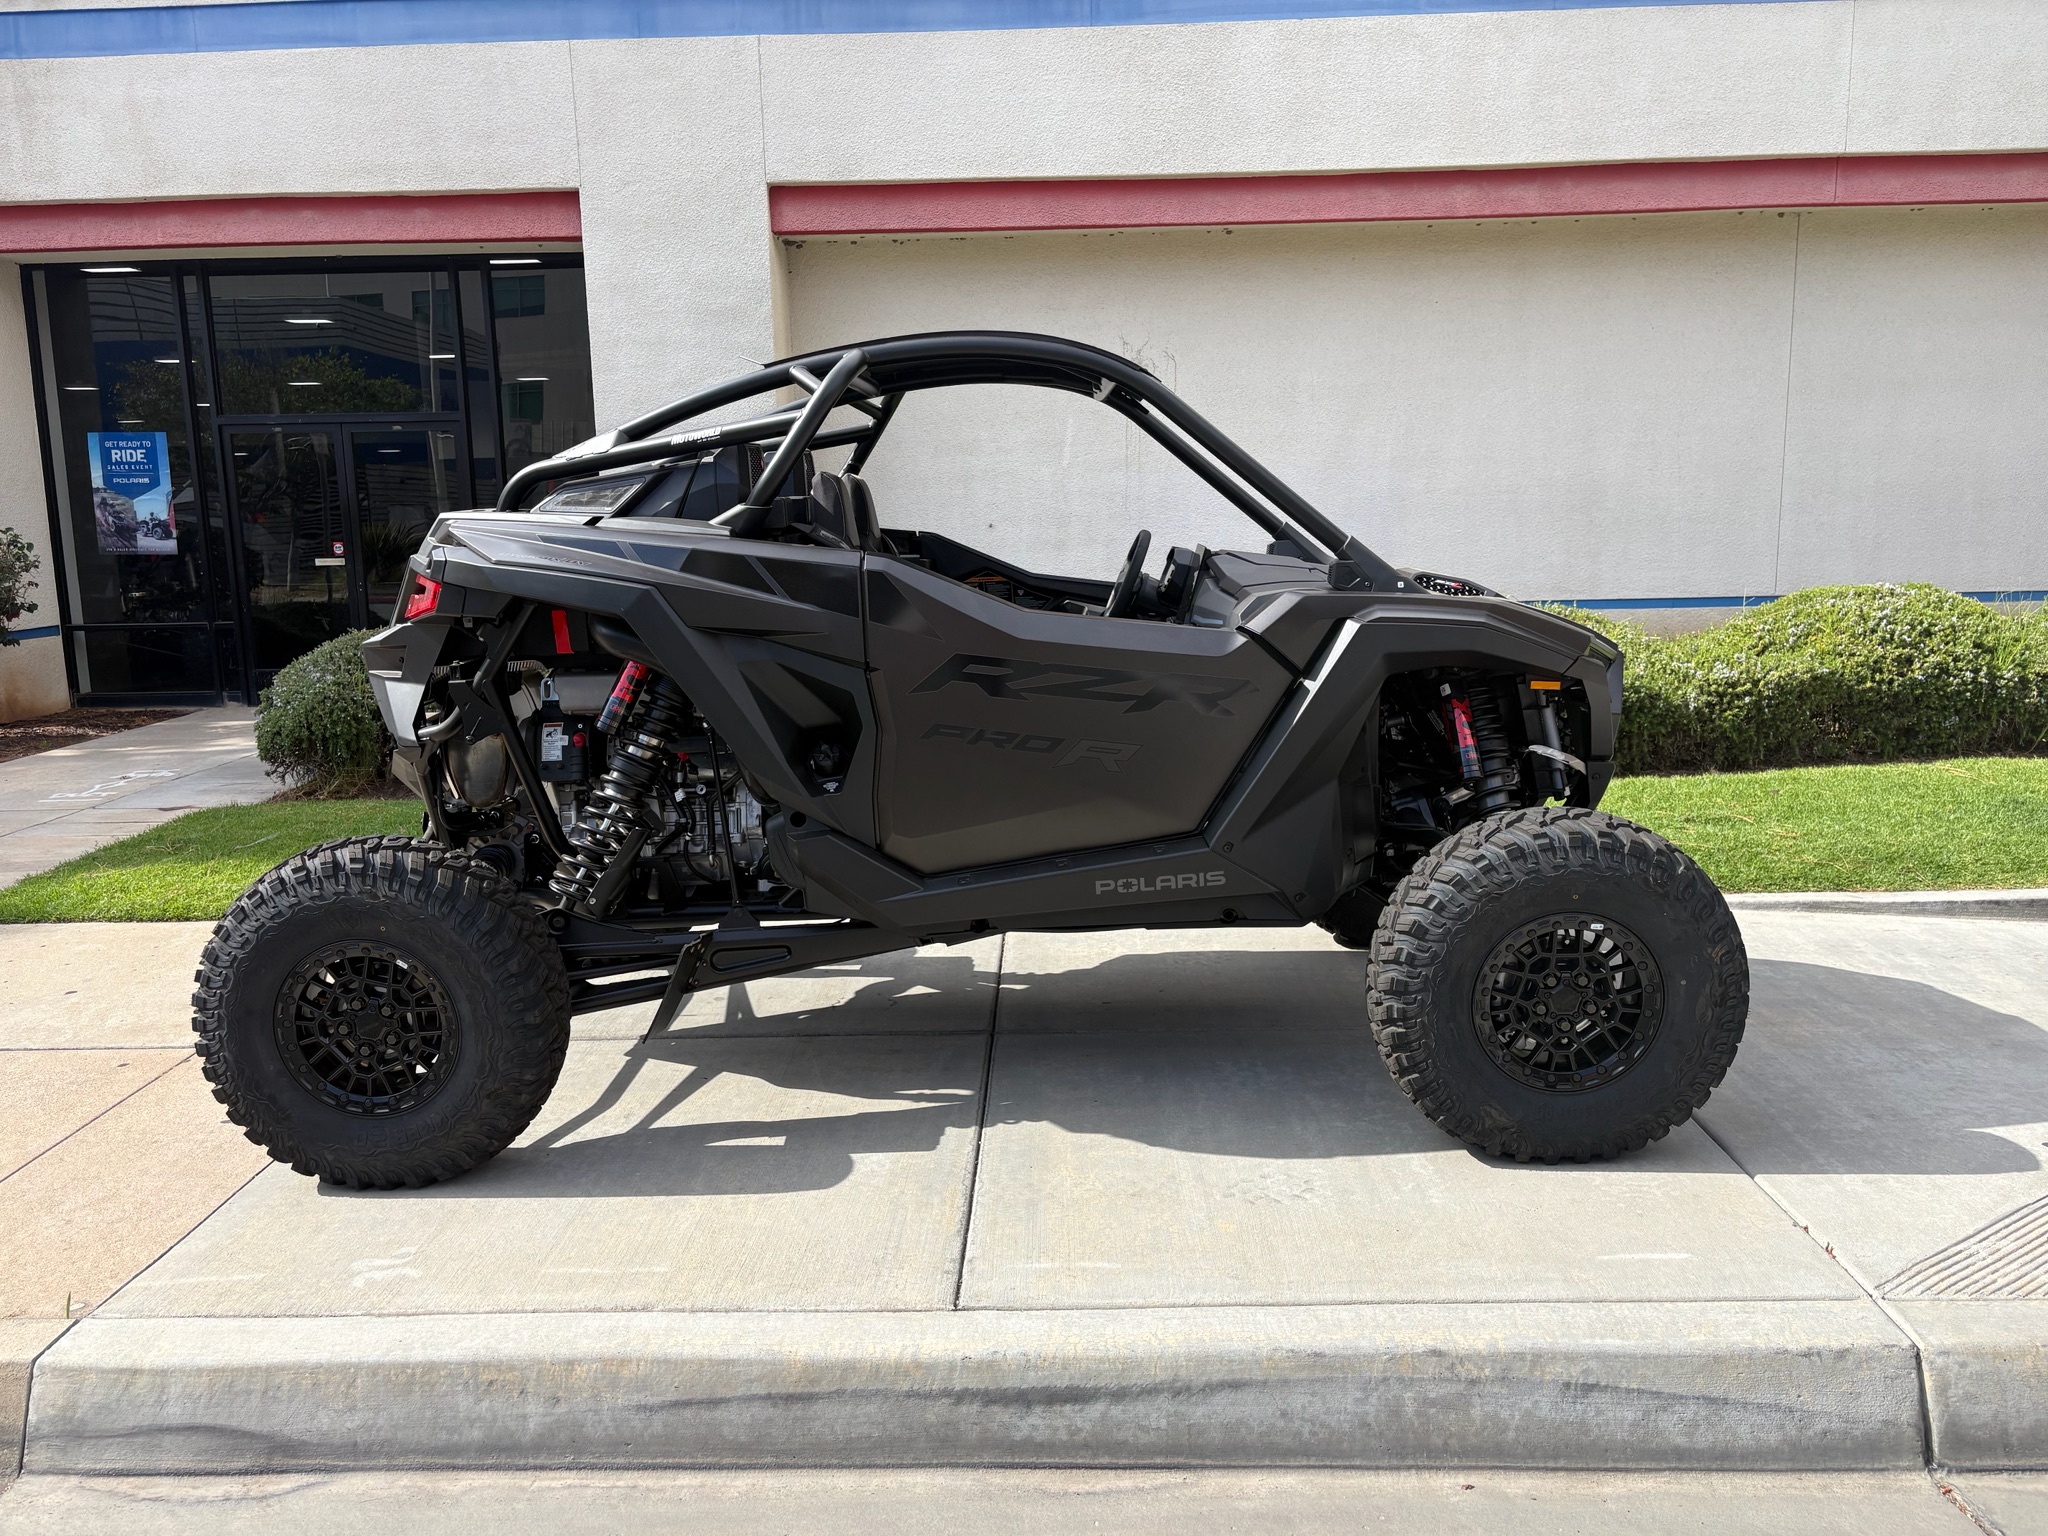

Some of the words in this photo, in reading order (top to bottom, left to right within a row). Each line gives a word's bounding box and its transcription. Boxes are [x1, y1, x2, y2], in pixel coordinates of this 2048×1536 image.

[104, 440, 118, 448] GET
[118, 440, 141, 448] READY
[142, 440, 151, 448] TO
[111, 449, 147, 463] RIDE
[907, 652, 1260, 718] RZR
[920, 723, 1066, 754] PRO
[1052, 738, 1143, 774] R
[1095, 870, 1227, 895] POLARIS
